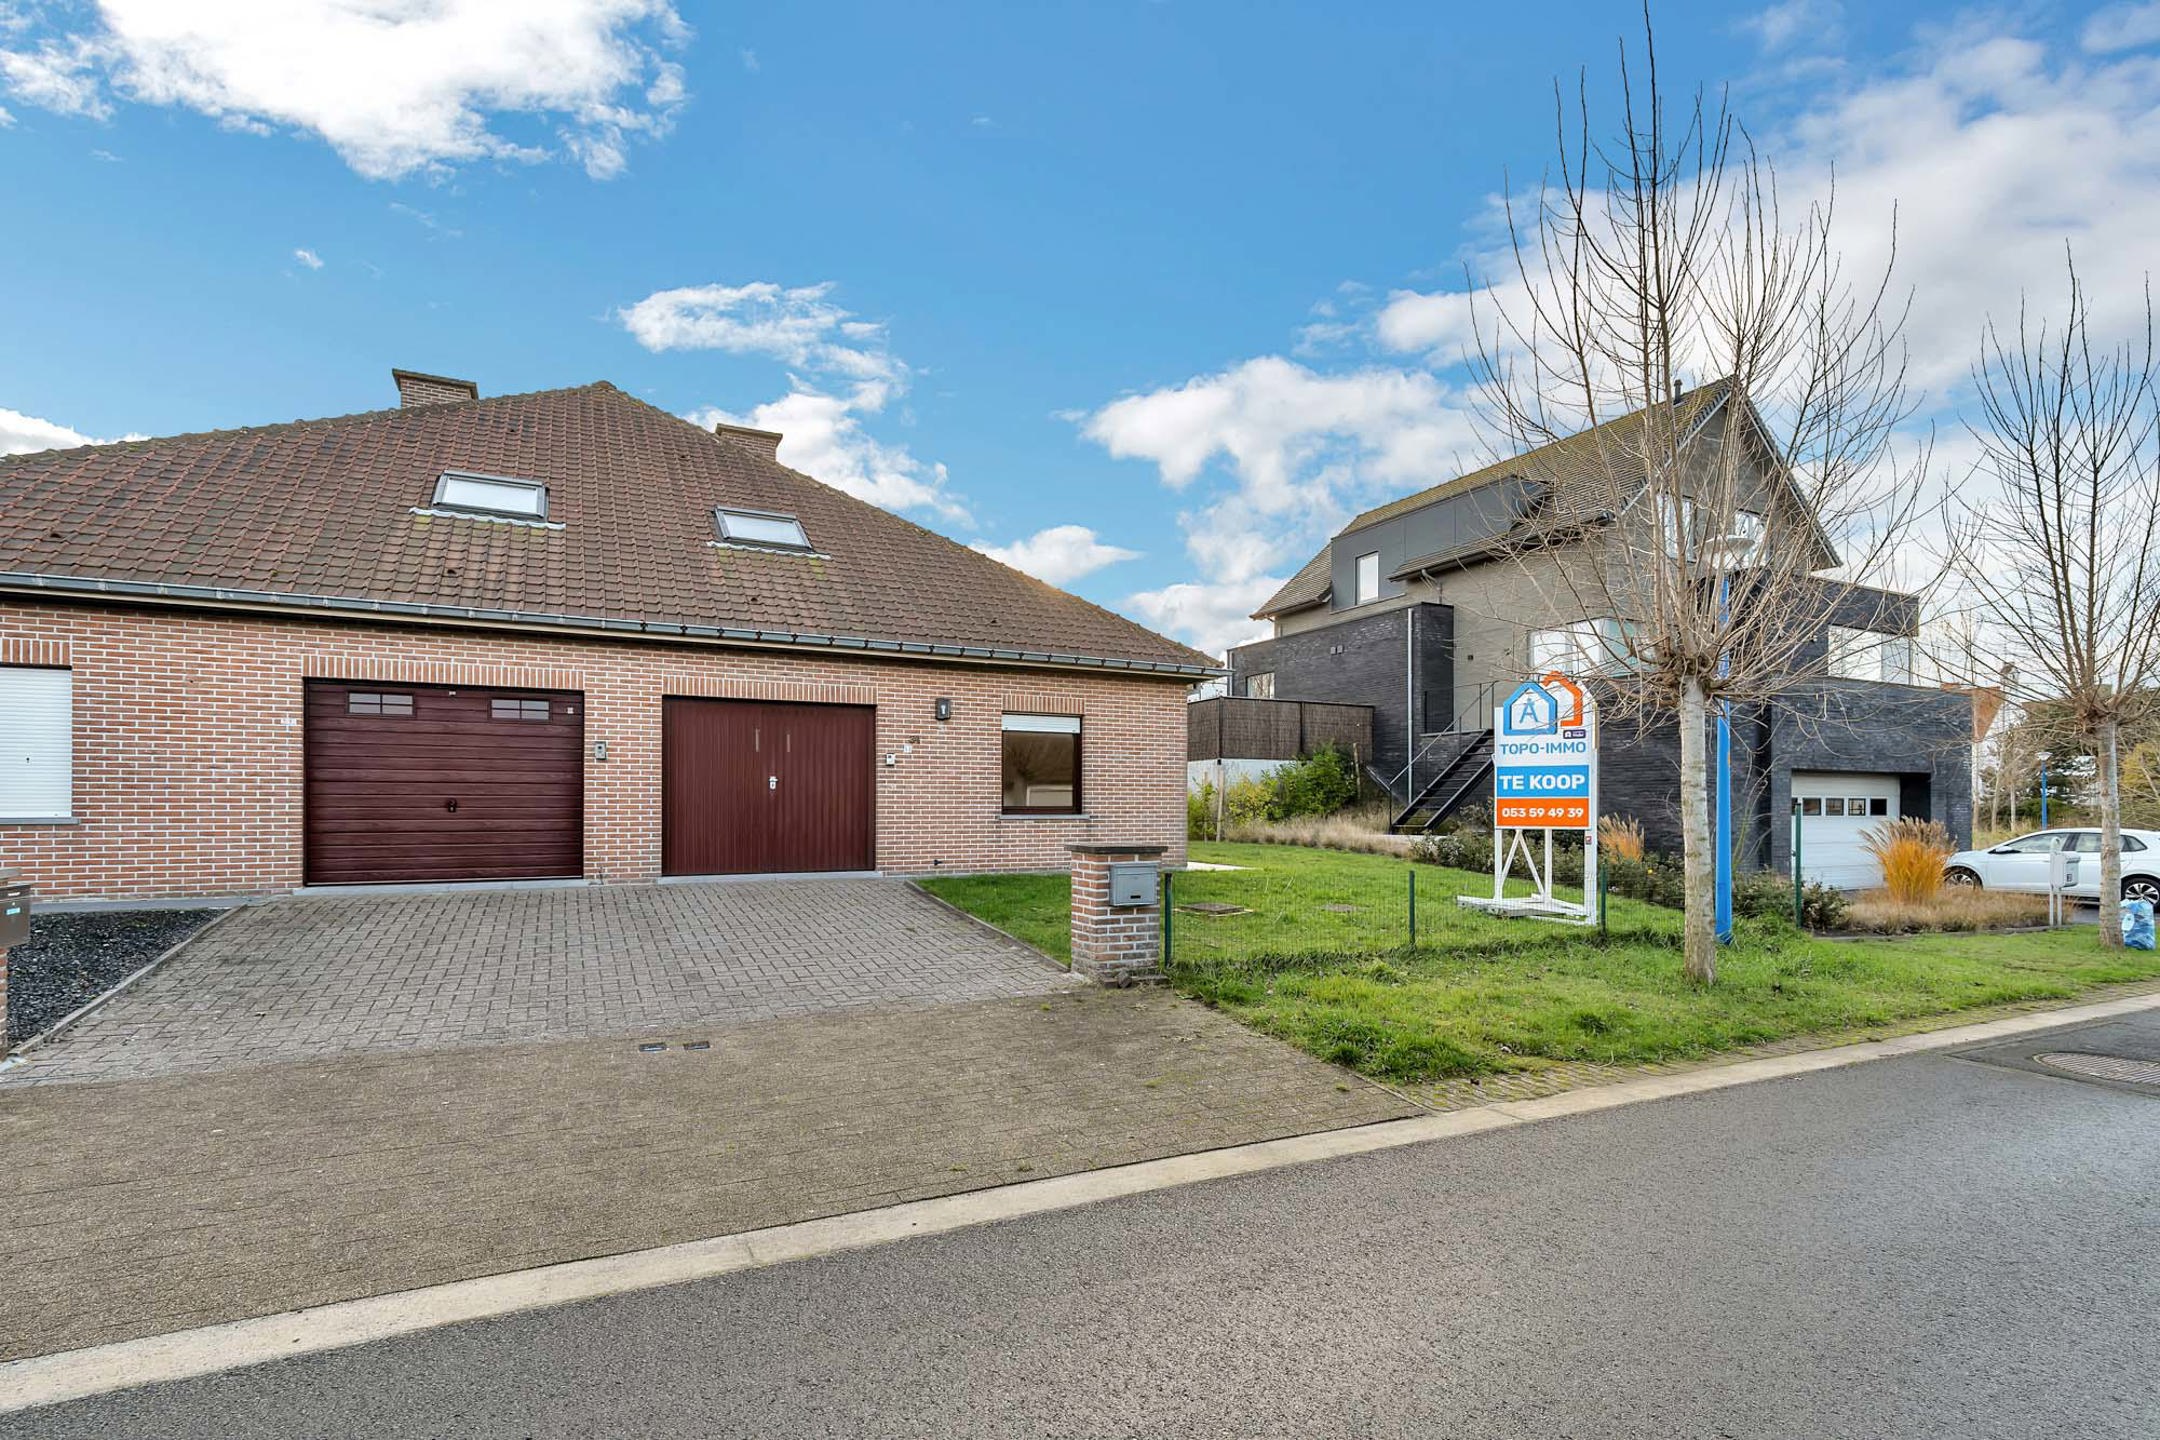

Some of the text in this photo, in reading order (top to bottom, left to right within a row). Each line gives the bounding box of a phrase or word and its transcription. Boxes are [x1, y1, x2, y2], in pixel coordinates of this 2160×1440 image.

[1499, 741, 1586, 755] TOPO-IMMO
[1499, 774, 1586, 790] TE KOOP
[1502, 807, 1584, 818] 053 59 49 39
